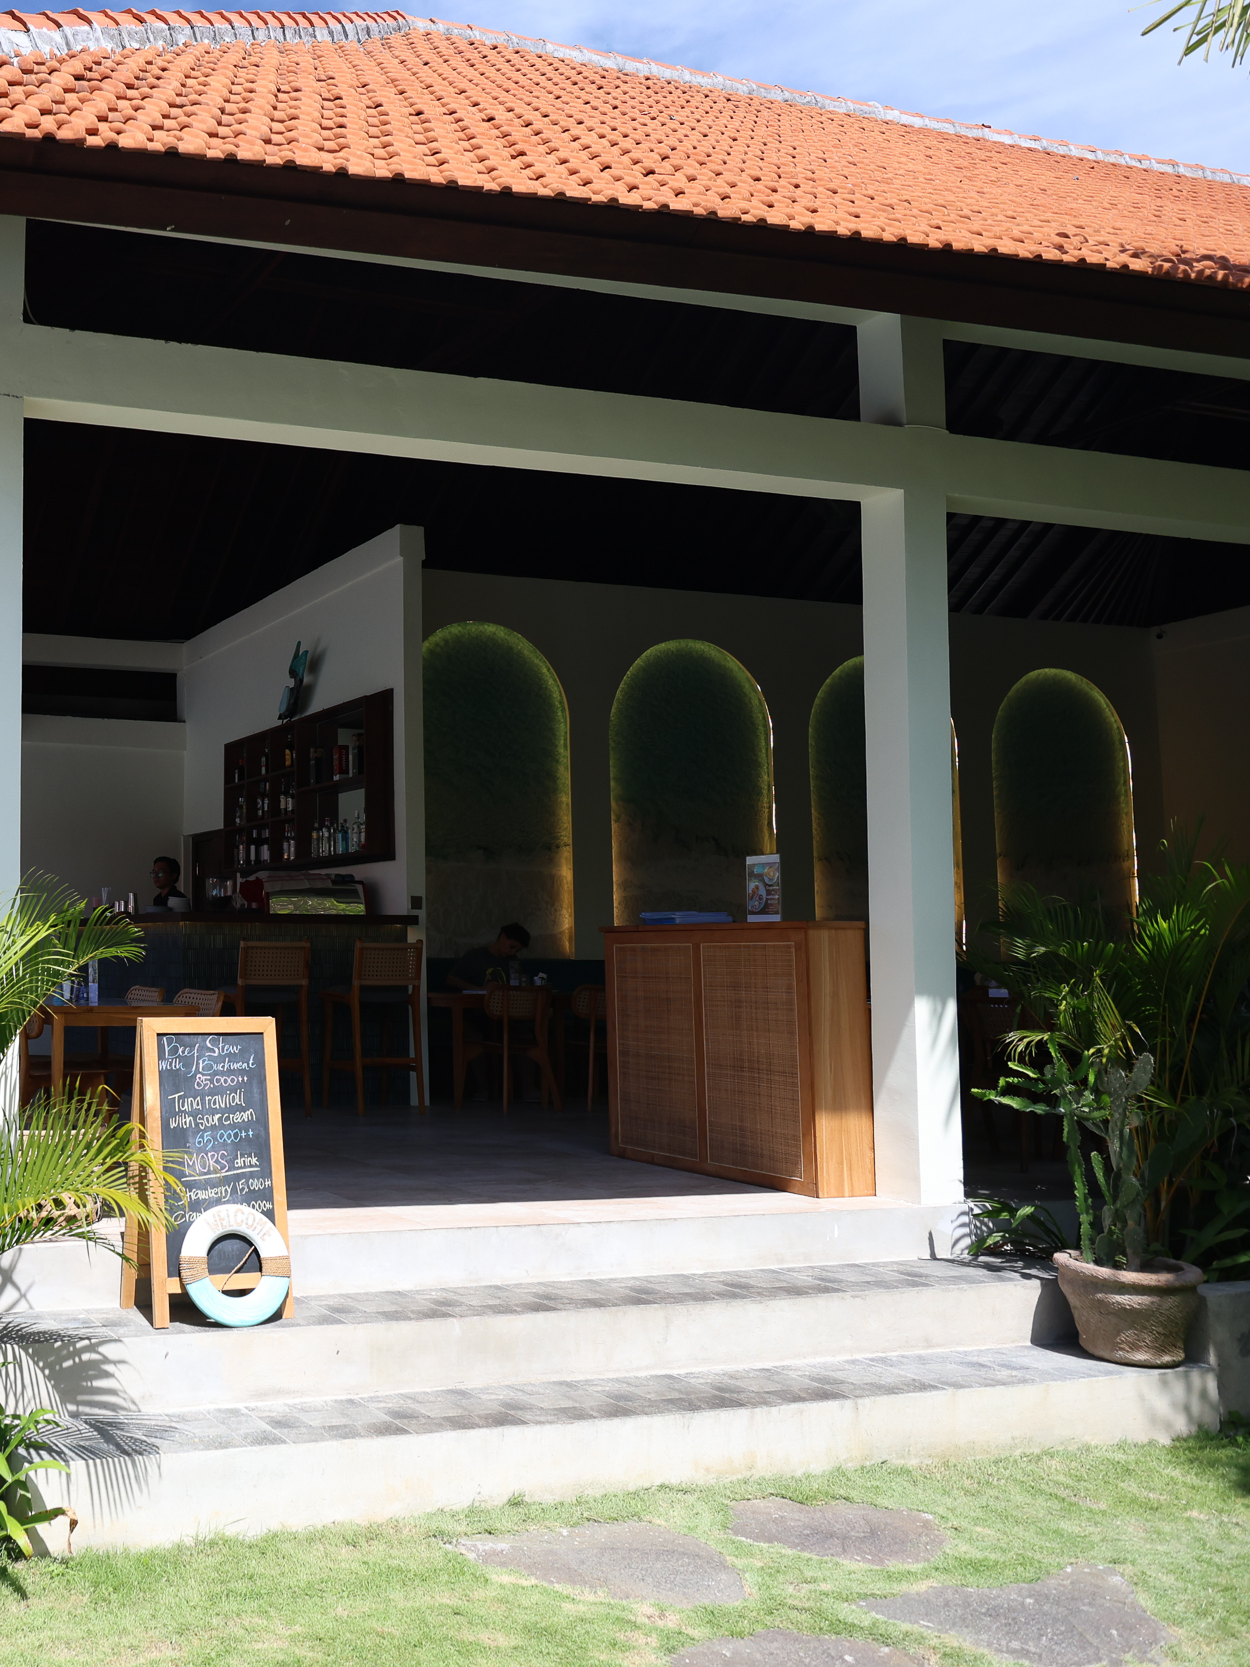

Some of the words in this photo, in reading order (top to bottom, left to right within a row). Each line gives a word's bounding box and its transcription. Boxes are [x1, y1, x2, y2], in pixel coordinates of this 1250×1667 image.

[161, 1035, 200, 1077] Beef
[205, 1035, 242, 1057] Stew
[194, 1074, 248, 1089] 85.000++
[168, 1091, 202, 1112] Tuna
[205, 1088, 246, 1110] ravioli
[169, 1113, 195, 1129] with
[196, 1113, 221, 1130] sour
[222, 1108, 256, 1123] cream
[195, 1128, 254, 1150] 65.000++
[184, 1151, 229, 1175] MORS
[234, 1152, 260, 1168] drink
[204, 1208, 275, 1242] WELCOME
